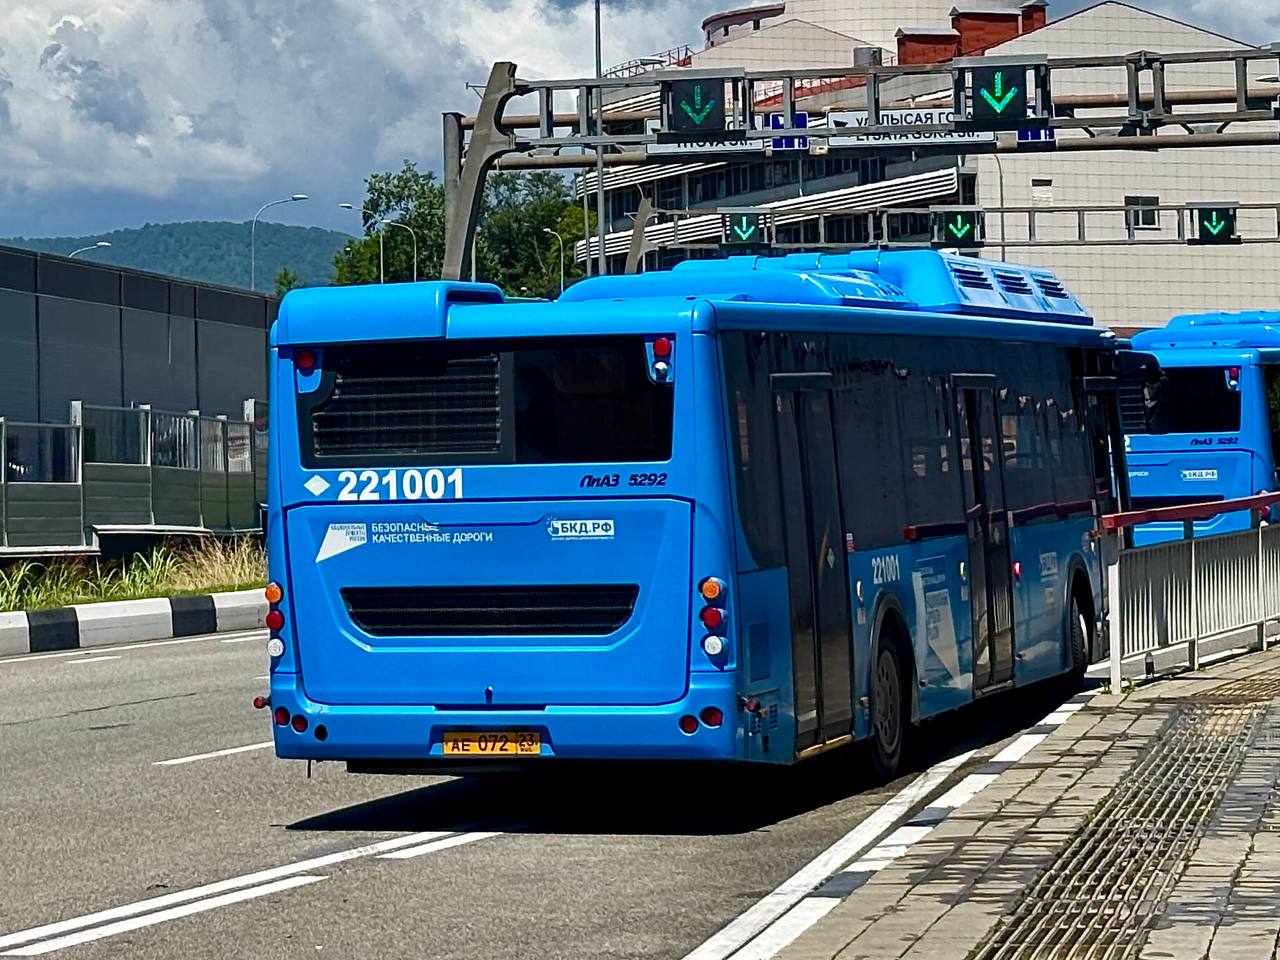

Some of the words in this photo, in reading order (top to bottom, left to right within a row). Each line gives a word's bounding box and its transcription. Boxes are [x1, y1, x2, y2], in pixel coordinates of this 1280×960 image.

[880, 112, 933, 126] ЛЫСАЯ
[938, 111, 974, 123] ГОА
[337, 468, 464, 501] 221001
[627, 472, 668, 487] 5292
[560, 521, 612, 534] БКД.РФ
[372, 533, 451, 544] КАЧЕСТВЕННЫЕ
[452, 531, 494, 544] ДОРОГИ
[871, 553, 901, 585] 221001
[478, 734, 509, 752] 072
